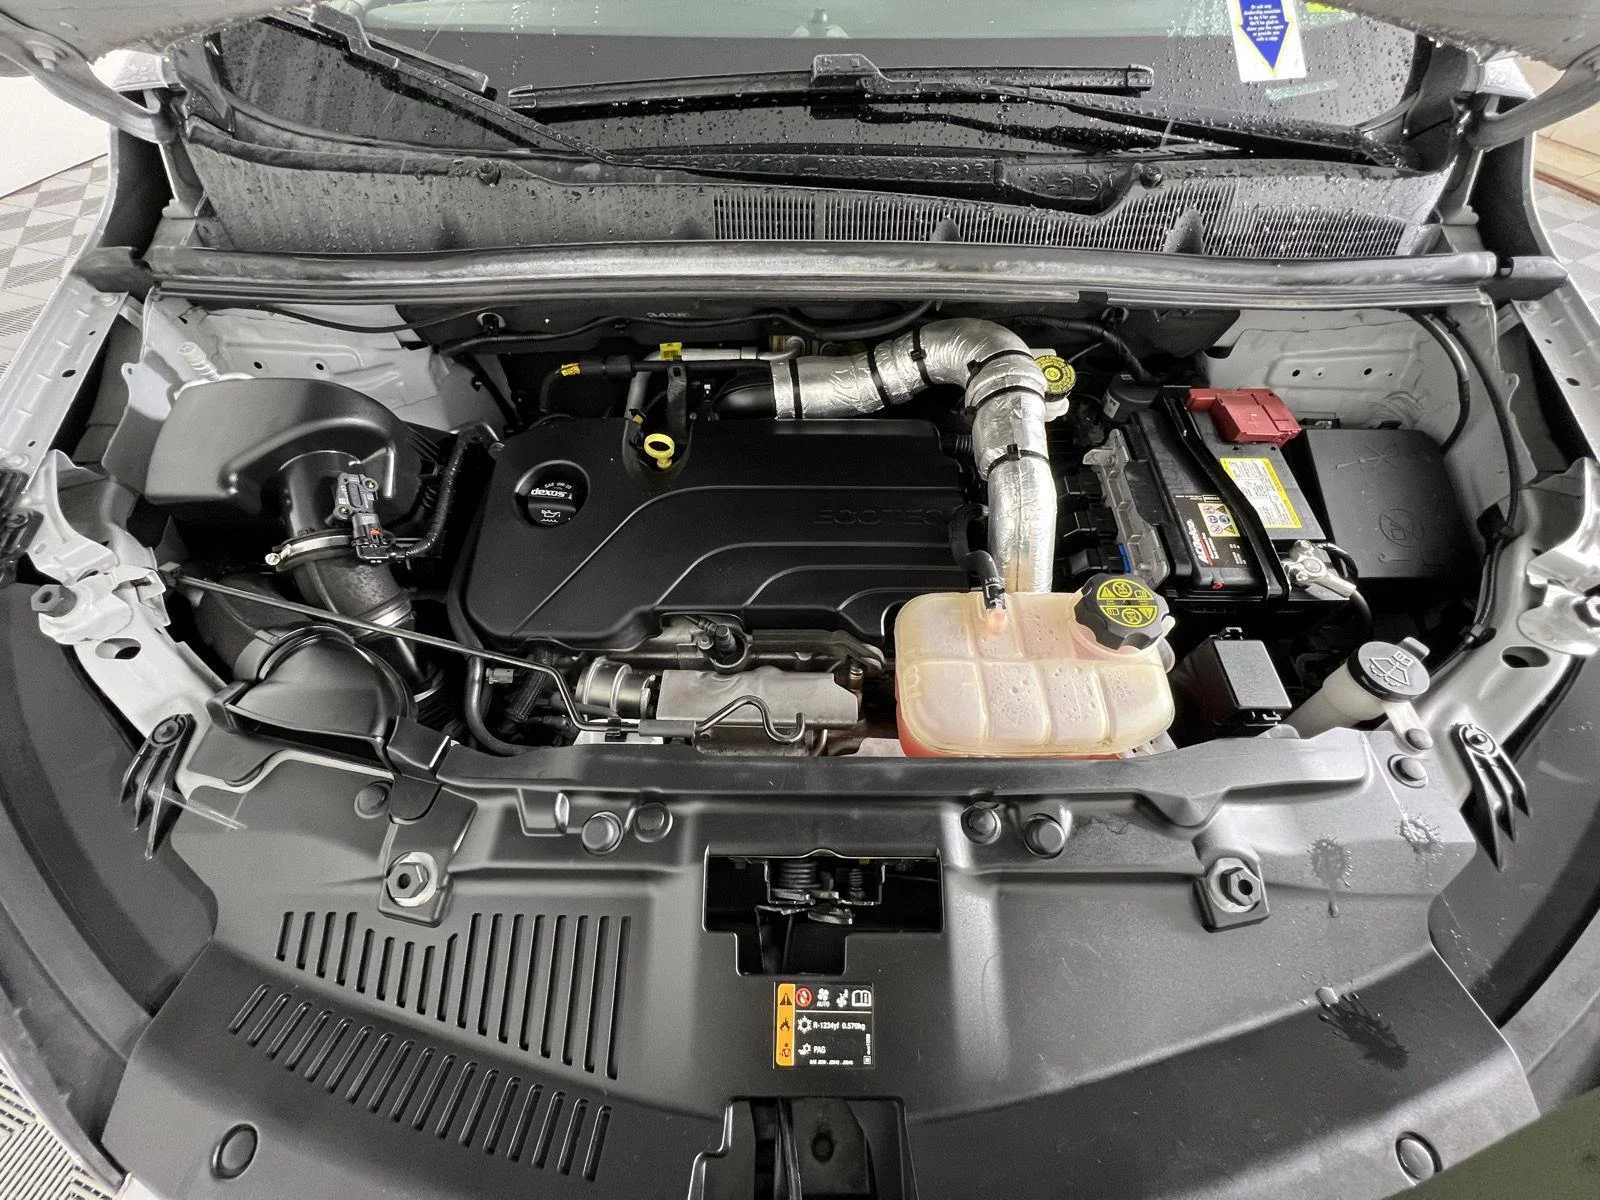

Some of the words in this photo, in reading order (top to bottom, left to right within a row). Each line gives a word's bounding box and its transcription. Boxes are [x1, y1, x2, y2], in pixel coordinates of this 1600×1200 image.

[813, 1021, 840, 1031] R-1234yf
[841, 1021, 866, 1031] 0.570kg
[813, 1045, 826, 1054] PAG
